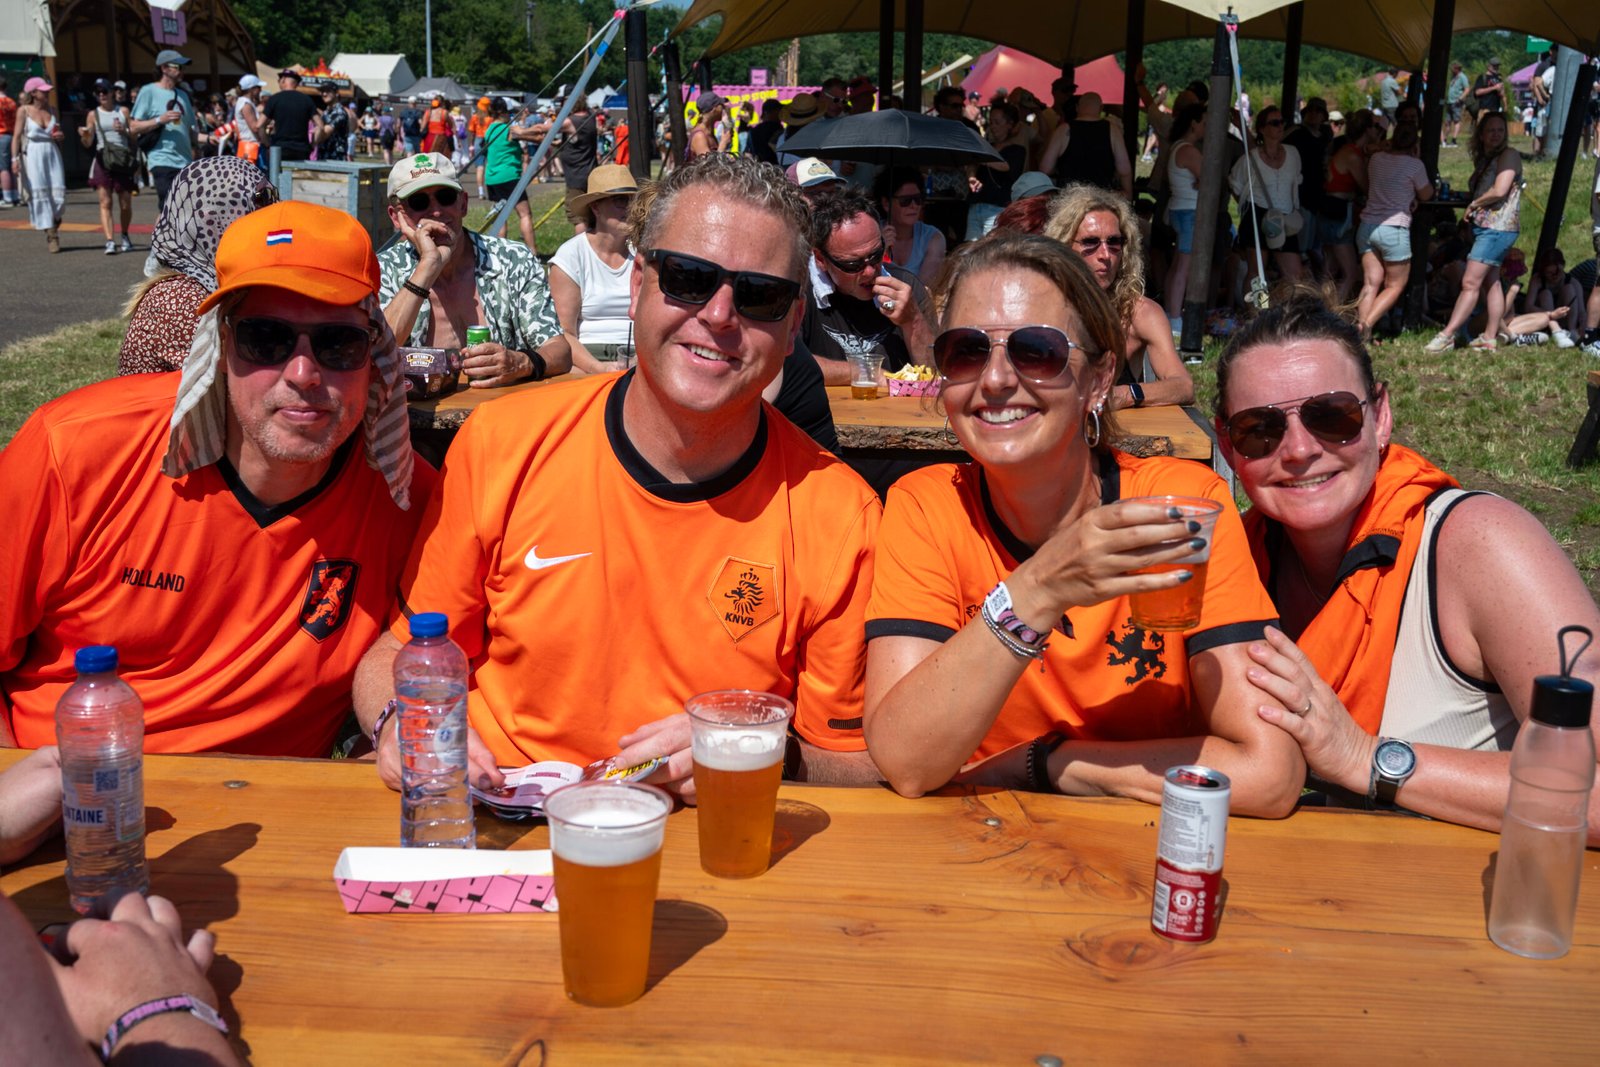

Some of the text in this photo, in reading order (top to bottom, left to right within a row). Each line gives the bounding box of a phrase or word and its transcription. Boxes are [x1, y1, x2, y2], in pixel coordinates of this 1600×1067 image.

[163, 18, 177, 33] BAR
[121, 567, 185, 593] HOLLAND
[725, 612, 755, 627] KNVB
